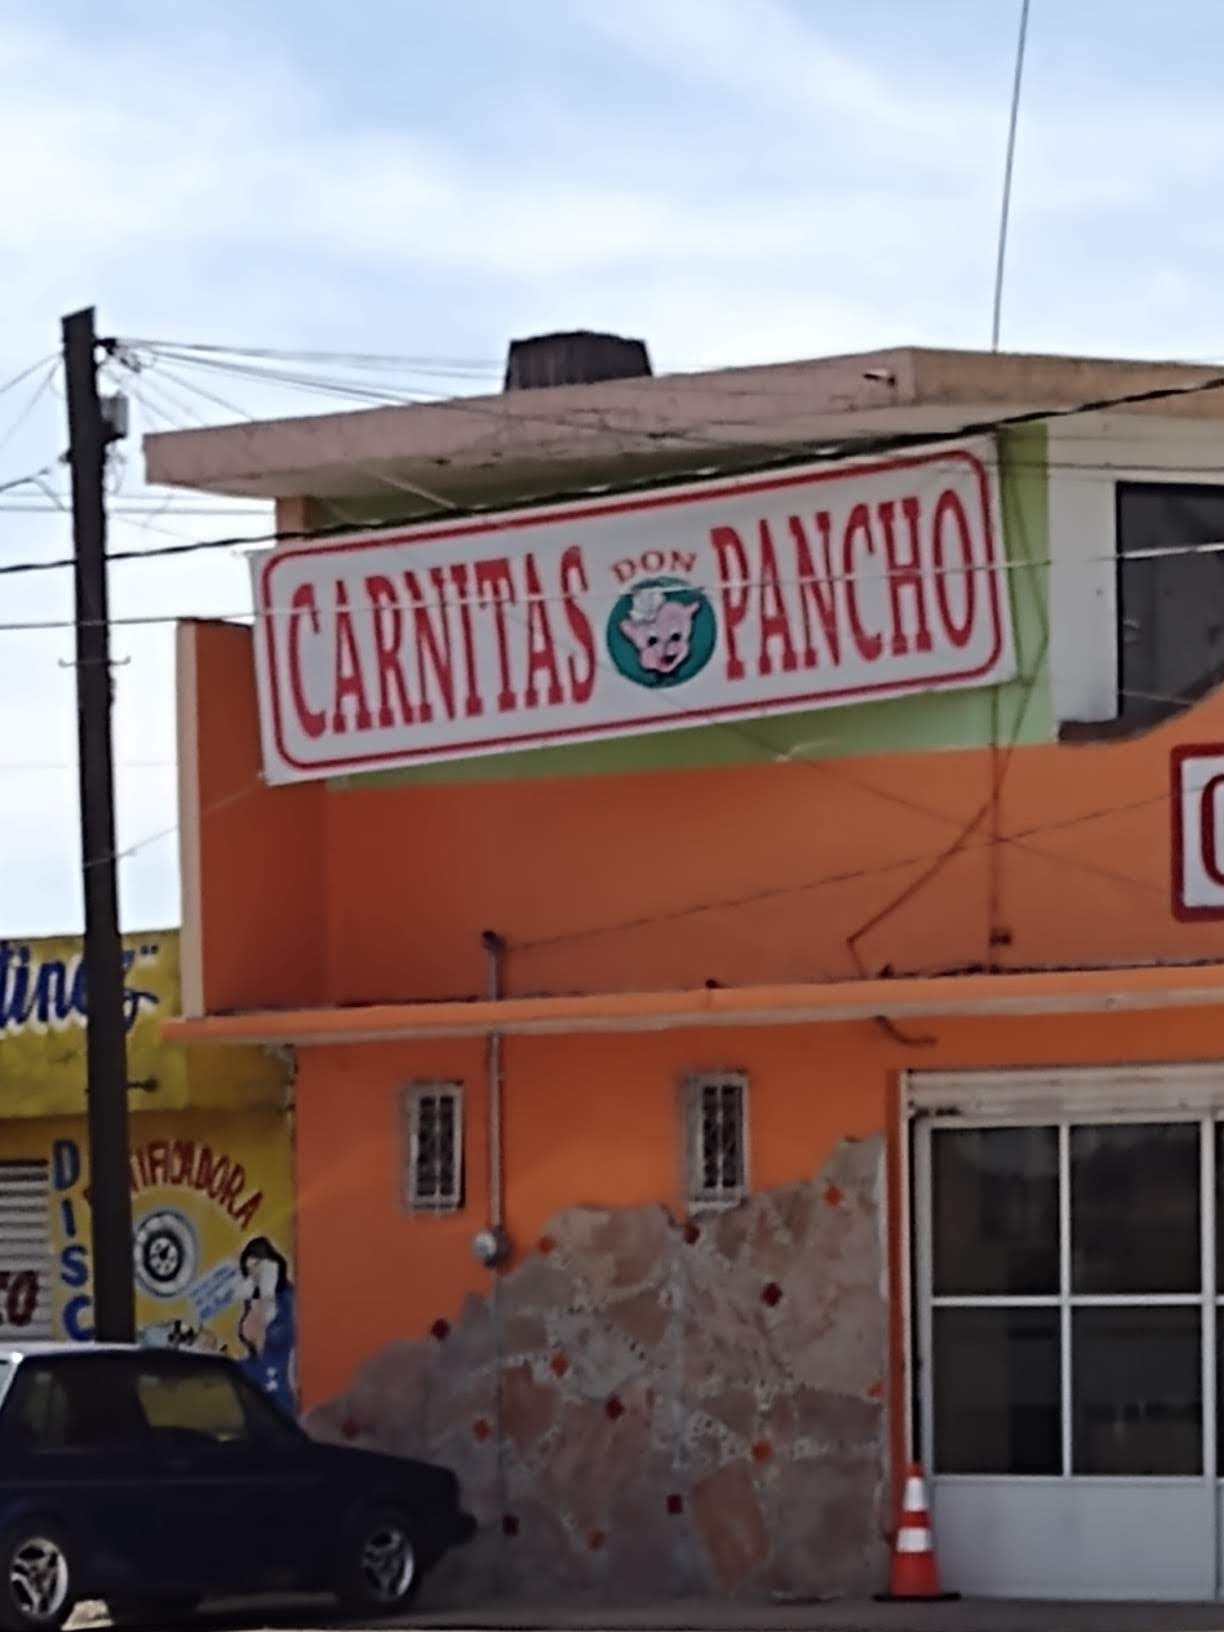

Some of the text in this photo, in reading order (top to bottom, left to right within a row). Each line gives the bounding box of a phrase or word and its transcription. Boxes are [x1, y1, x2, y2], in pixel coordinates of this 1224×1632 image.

[288, 488, 976, 740] CARNITAS DON PANCHO
